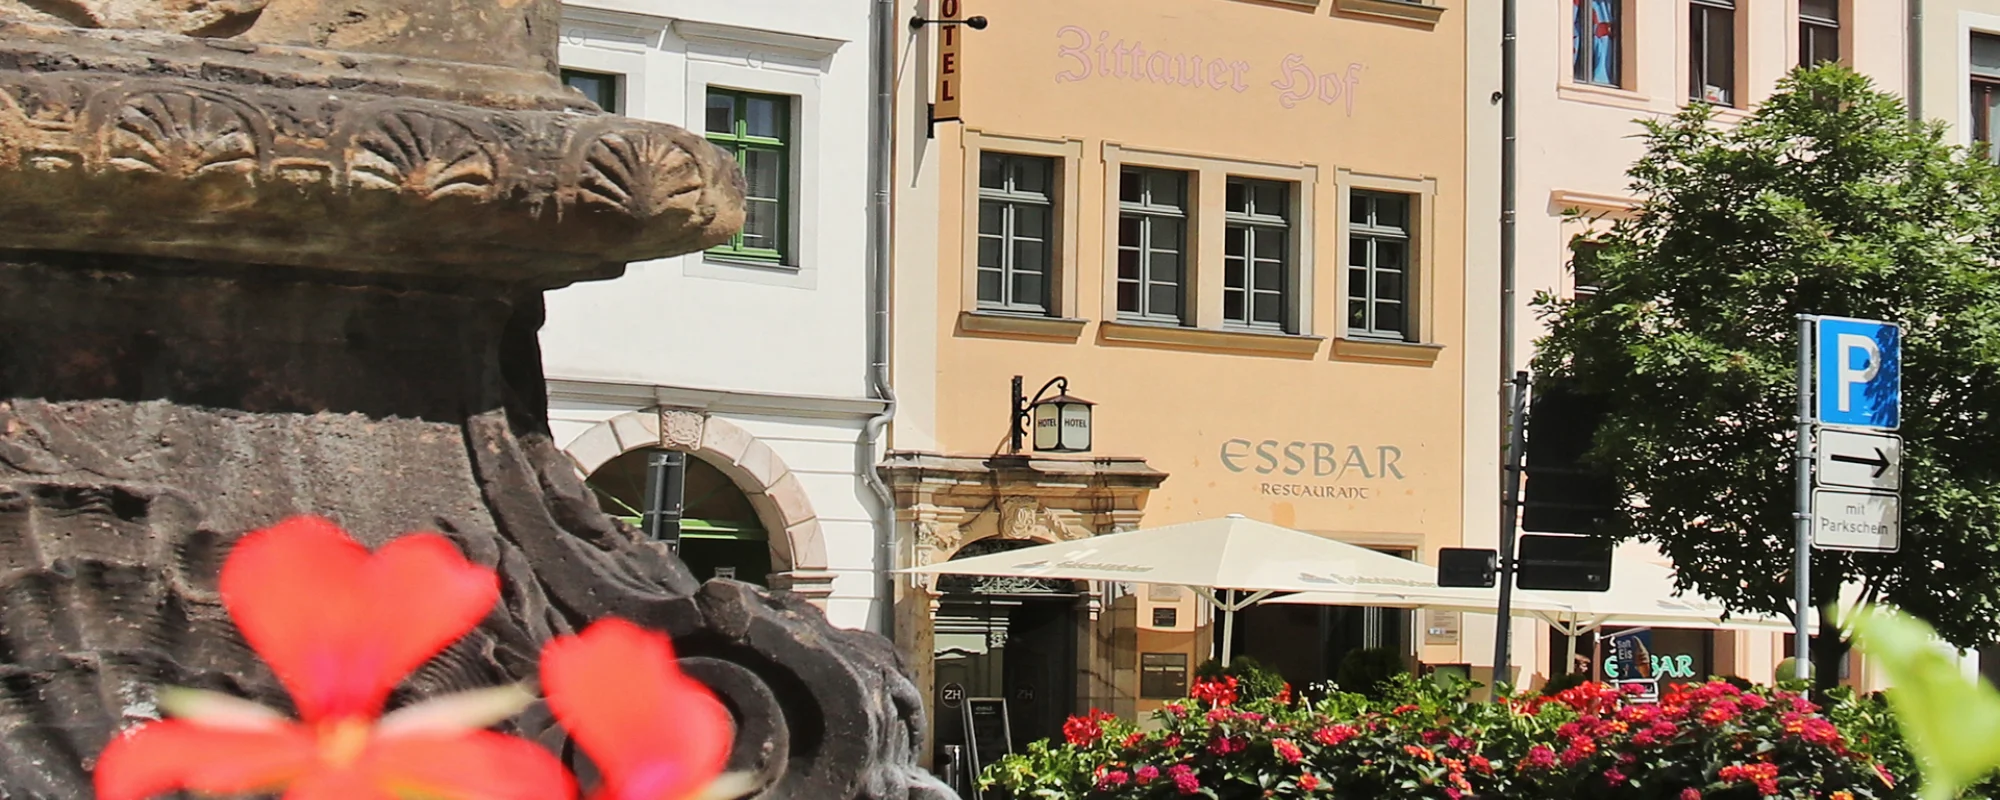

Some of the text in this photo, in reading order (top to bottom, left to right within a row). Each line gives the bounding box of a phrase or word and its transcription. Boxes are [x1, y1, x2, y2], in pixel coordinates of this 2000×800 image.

[1055, 25, 1362, 118] Zittauer Hof
[1837, 333, 1880, 412] P
[1037, 418, 1057, 428] HOTEL
[1064, 418, 1087, 428] HOTEL
[1220, 438, 1406, 482] ESSBAR
[1261, 483, 1369, 499] RESTAURANT
[1846, 503, 1865, 515] mit
[1821, 516, 1889, 535] Parkschein
[1618, 648, 1633, 660] Eis
[1604, 654, 1696, 680] EBAR
[944, 689, 961, 700] ZH
[1016, 689, 1034, 700] ZH
